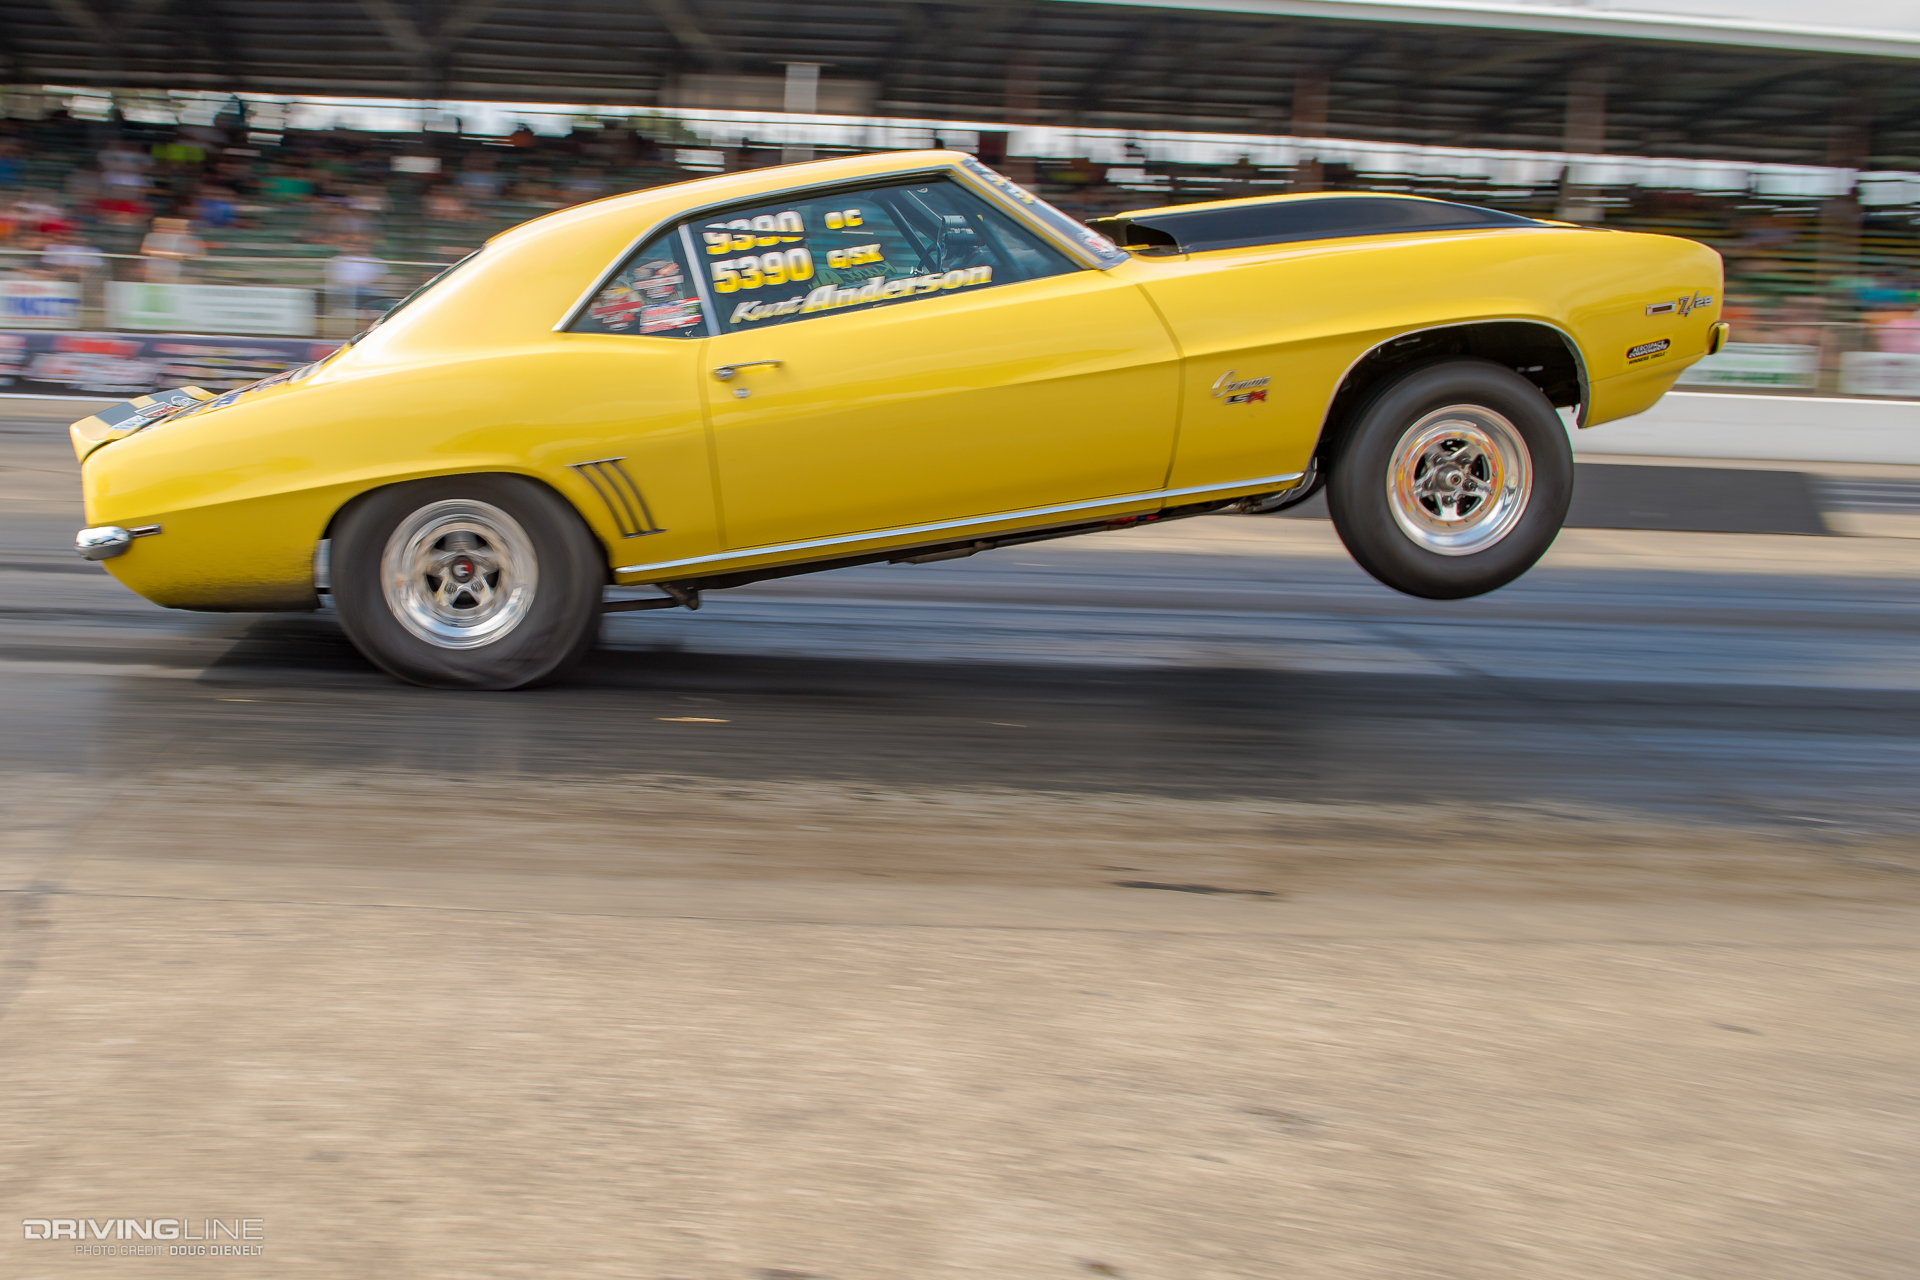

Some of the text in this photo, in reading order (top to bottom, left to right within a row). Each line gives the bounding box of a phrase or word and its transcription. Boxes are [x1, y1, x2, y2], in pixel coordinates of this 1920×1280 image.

[710, 248, 814, 293] 5390
[730, 296, 806, 323] Kurt
[799, 265, 992, 314] Anderson
